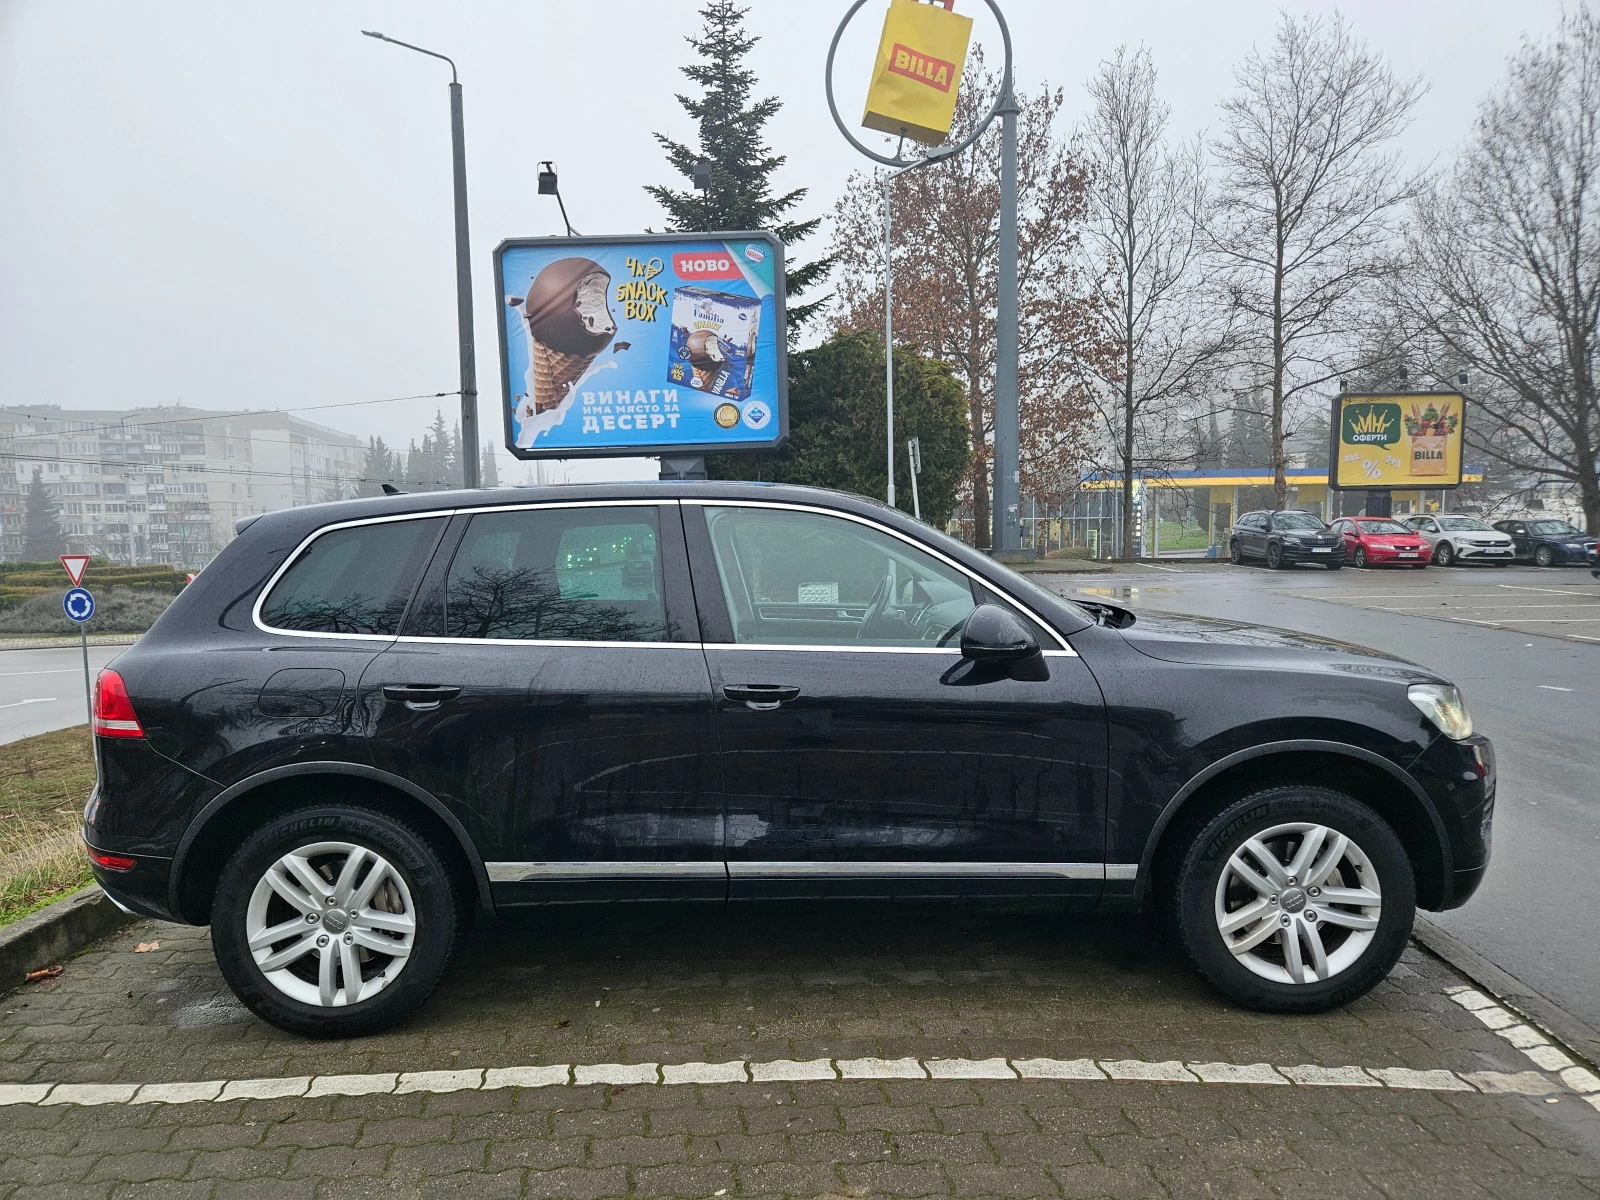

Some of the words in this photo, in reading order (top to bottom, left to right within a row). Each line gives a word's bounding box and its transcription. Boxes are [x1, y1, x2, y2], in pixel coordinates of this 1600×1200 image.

[894, 49, 948, 87] BILLA
[626, 257, 646, 278] 4x
[680, 259, 730, 273] НОВО
[615, 280, 668, 307] SNACK
[624, 300, 657, 322] BOX
[693, 308, 725, 324] Familia
[711, 370, 731, 395] VANILLA
[581, 389, 678, 405] ВИНАГИ
[582, 405, 611, 414] ИМА
[615, 404, 660, 414] МЯСТО
[664, 404, 680, 412] ЗА
[582, 413, 680, 434] ДЕСЕРТ
[1352, 434, 1387, 442] ОФЕРТИ
[1414, 450, 1443, 460] BILLA
[346, 820, 375, 833] PILOT
